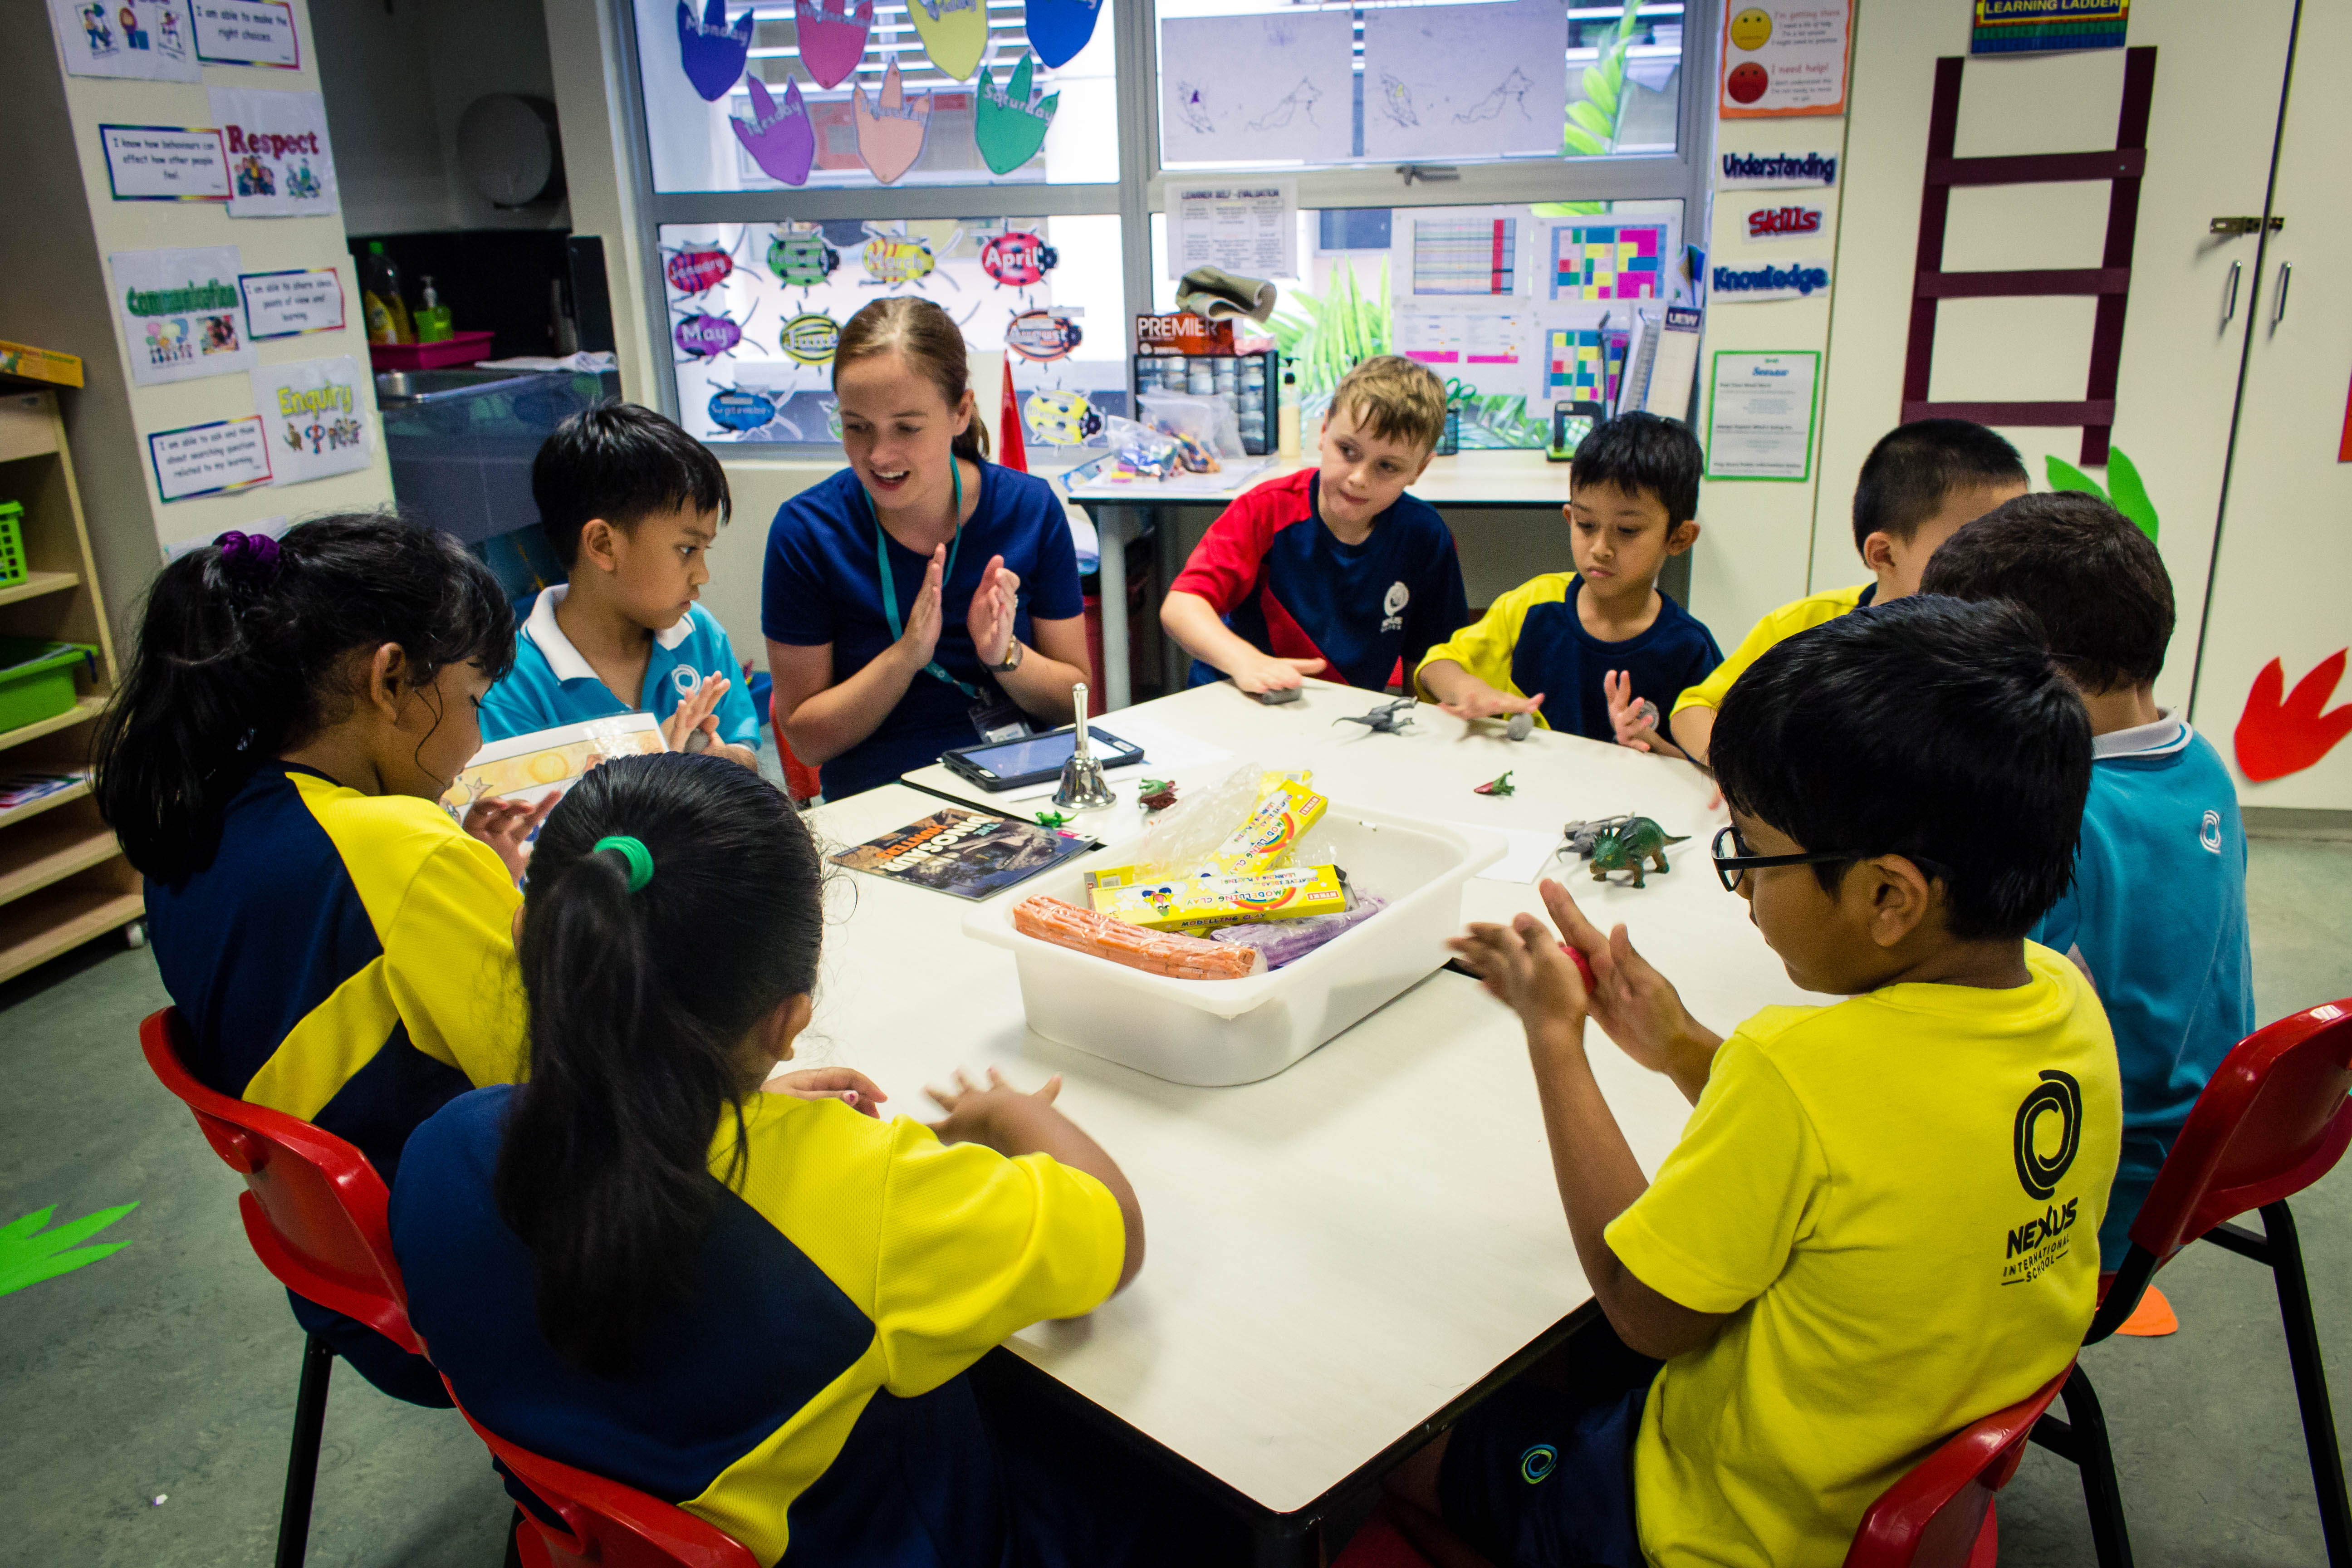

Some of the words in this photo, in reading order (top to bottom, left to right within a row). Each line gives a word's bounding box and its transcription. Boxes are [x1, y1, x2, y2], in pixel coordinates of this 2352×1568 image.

[206, 10, 217, 18] am
[1985, 0, 2058, 14] LEARNING
[2061, 0, 2120, 10] LADDER
[218, 29, 238, 41] right
[686, 15, 749, 47] Monday
[1779, 65, 1802, 74] need
[983, 83, 1054, 127] Saturday
[744, 102, 804, 137] Tuesday
[122, 138, 141, 147] know
[144, 139, 158, 148] how
[226, 125, 318, 160] Respect
[151, 155, 165, 164] how
[1723, 152, 1836, 184] Understanding
[1749, 207, 1822, 237] Skills
[867, 251, 923, 270] March
[985, 246, 1042, 271] April
[1713, 263, 1829, 295] Knowledge
[682, 323, 727, 346] May
[1138, 317, 1218, 337] PREMIER
[784, 329, 839, 352] June
[277, 378, 353, 420] Enquiry
[1254, 802, 1274, 822] LEARNING
[1273, 794, 1293, 814] CREATIVE
[973, 823, 1001, 836] THE
[1246, 817, 1285, 858] MODELLING
[876, 824, 948, 859] HUNTERS
[879, 815, 993, 872] DINOSAUR
[1229, 859, 1246, 875] CLAY
[1262, 872, 1296, 881] LEARNING
[1286, 877, 1318, 885] CREATIVE
[1187, 897, 1212, 906] CLAY
[1218, 889, 1284, 902] MODELLING
[1308, 892, 1338, 900] NIKKI
[1181, 916, 1238, 927] MODELLING
[2007, 1196, 2078, 1259] NEXUS
[2003, 1234, 2069, 1277] INTERNATIONAL
[2026, 1256, 2055, 1282] SCHOOL
